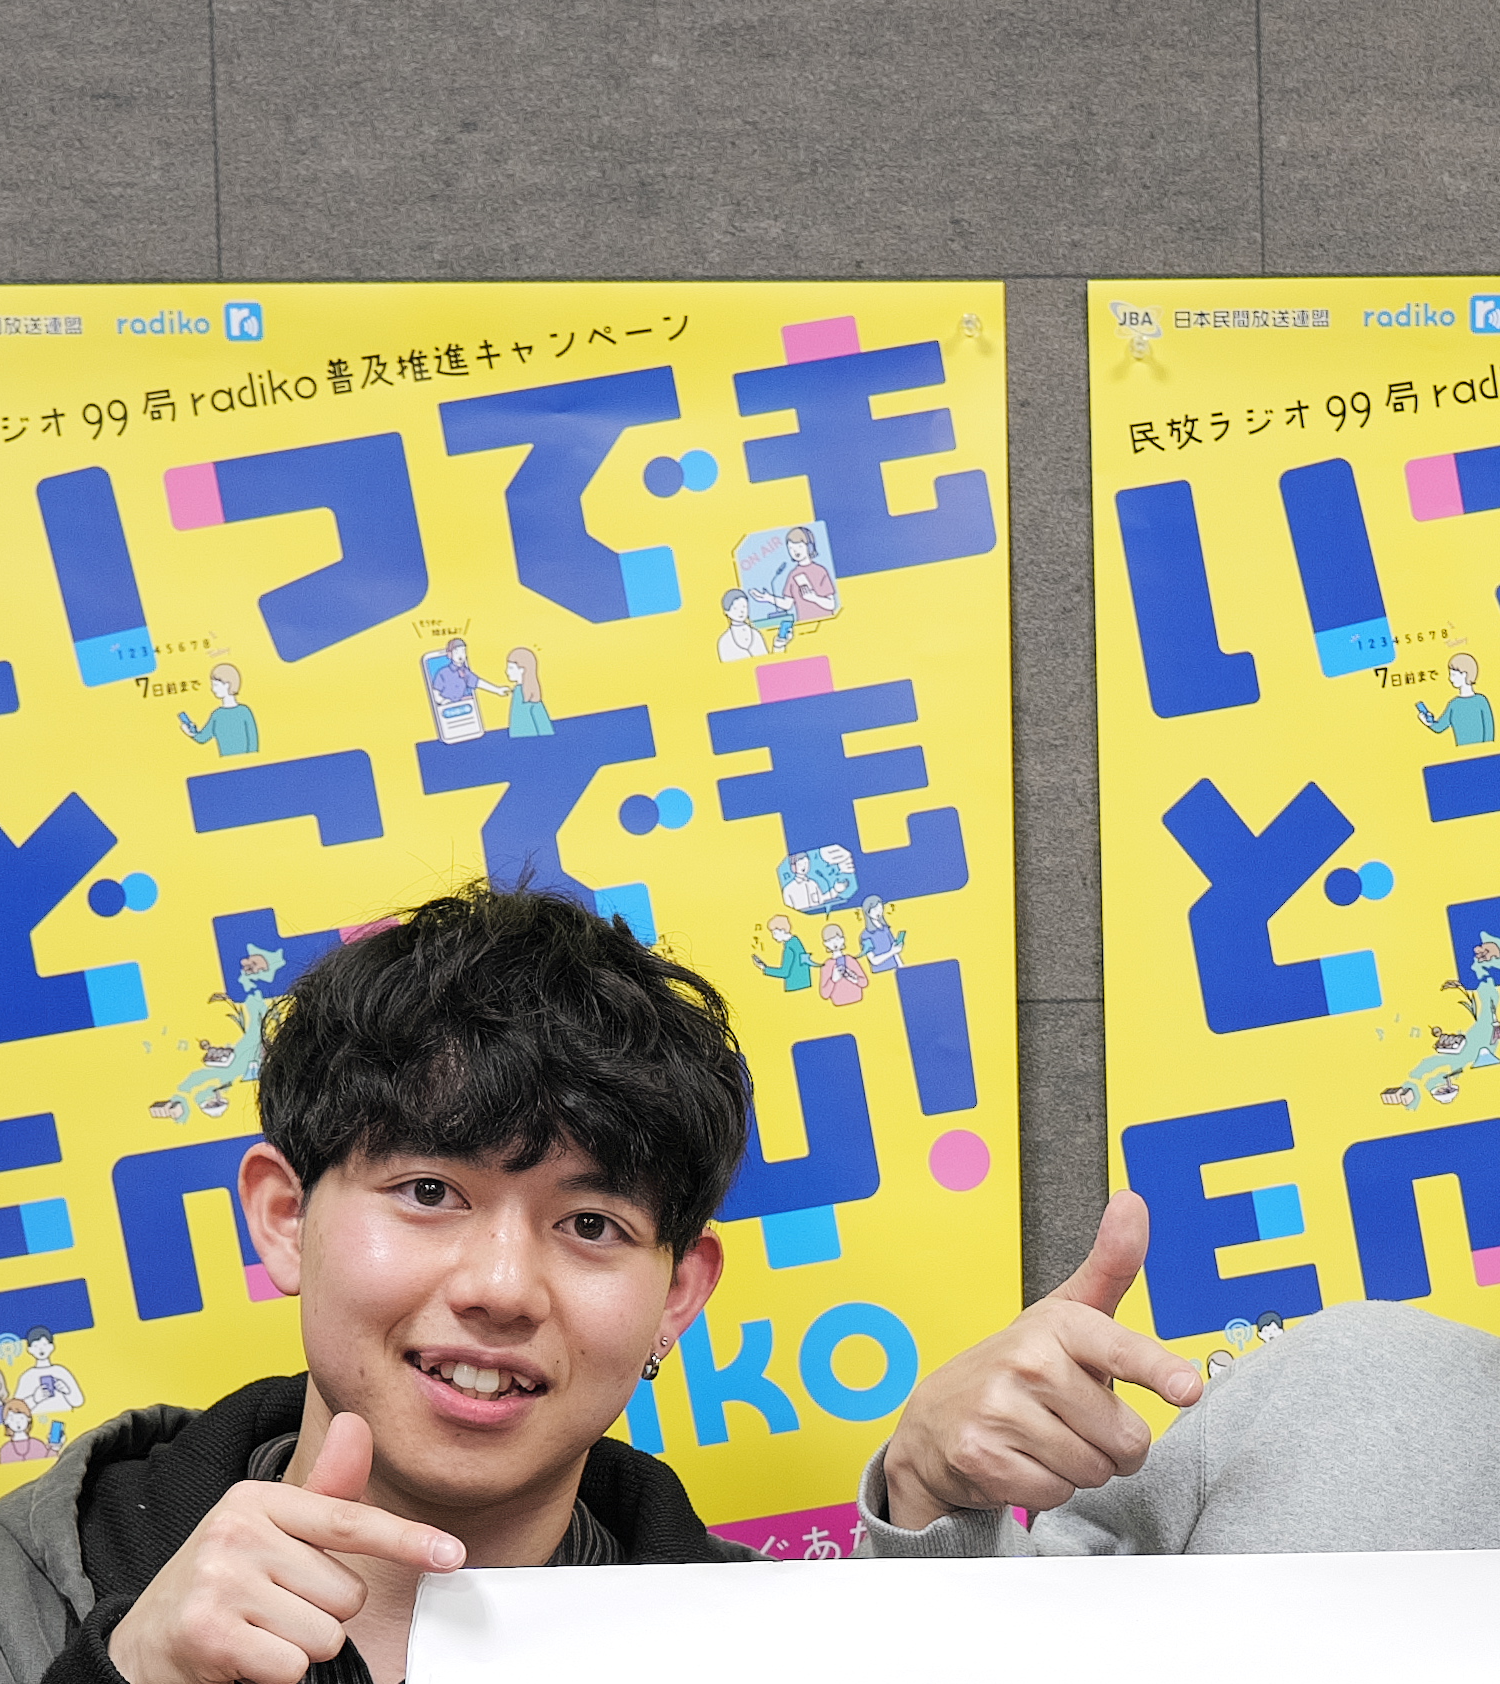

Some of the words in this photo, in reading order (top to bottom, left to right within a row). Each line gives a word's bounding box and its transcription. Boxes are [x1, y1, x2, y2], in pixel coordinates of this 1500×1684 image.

[117, 310, 211, 335] radiko
[1118, 312, 1153, 326] JBA
[1174, 309, 1330, 329] 日本民間放送連盟
[1363, 303, 1456, 328] radiko
